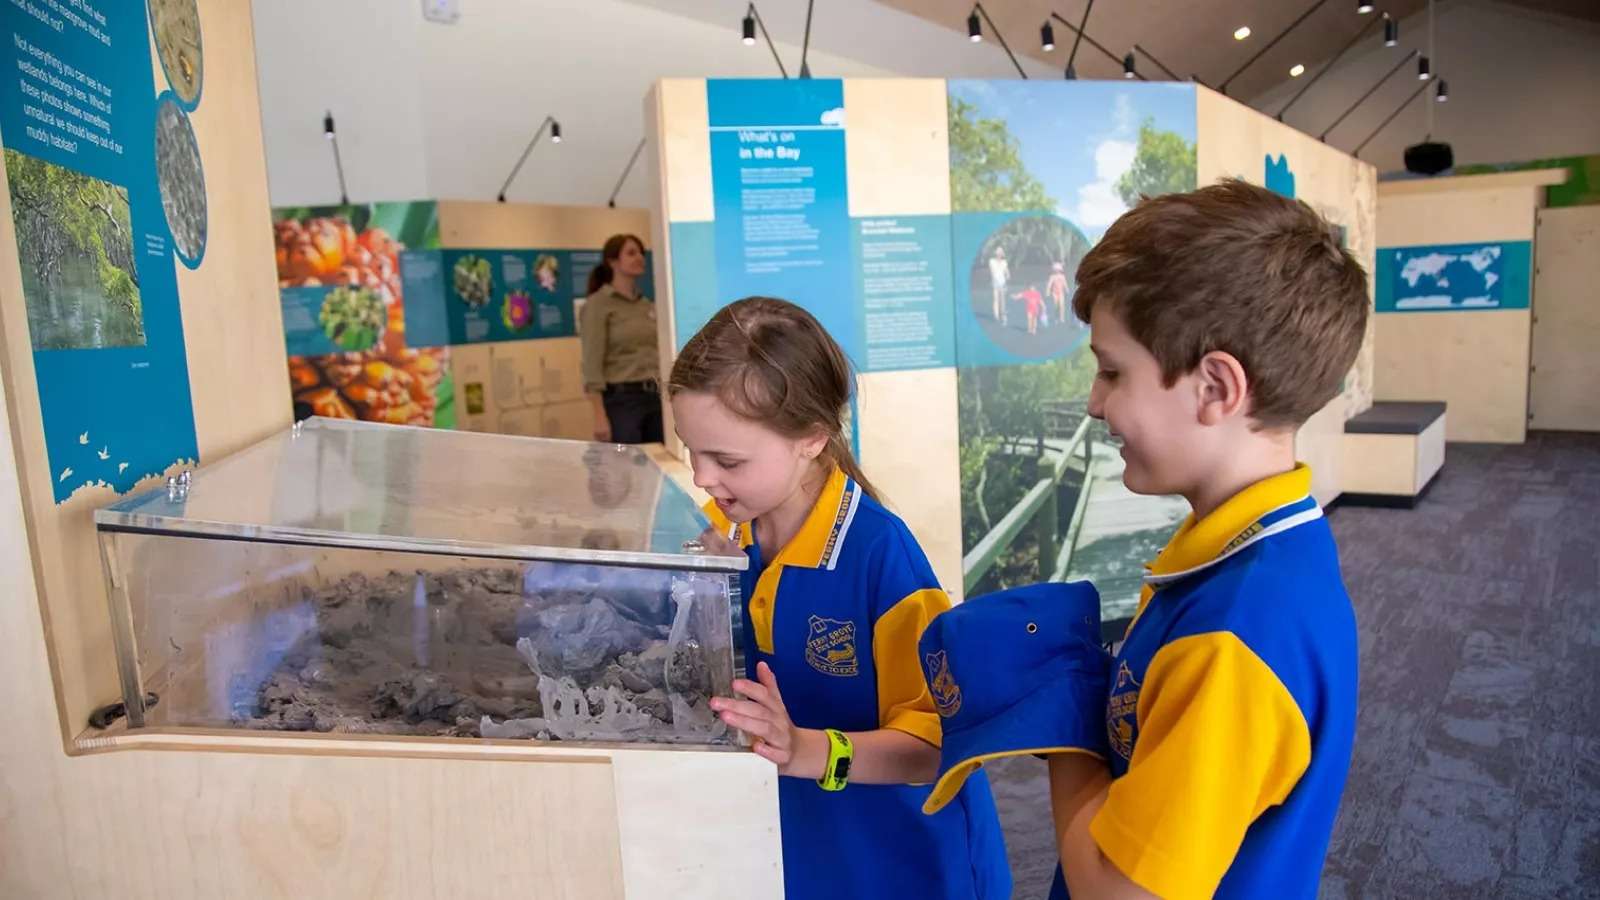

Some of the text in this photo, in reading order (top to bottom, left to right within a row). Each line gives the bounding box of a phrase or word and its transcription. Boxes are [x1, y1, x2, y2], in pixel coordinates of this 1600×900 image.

[738, 130, 796, 144] What's on
[739, 146, 801, 162] in the Bay
